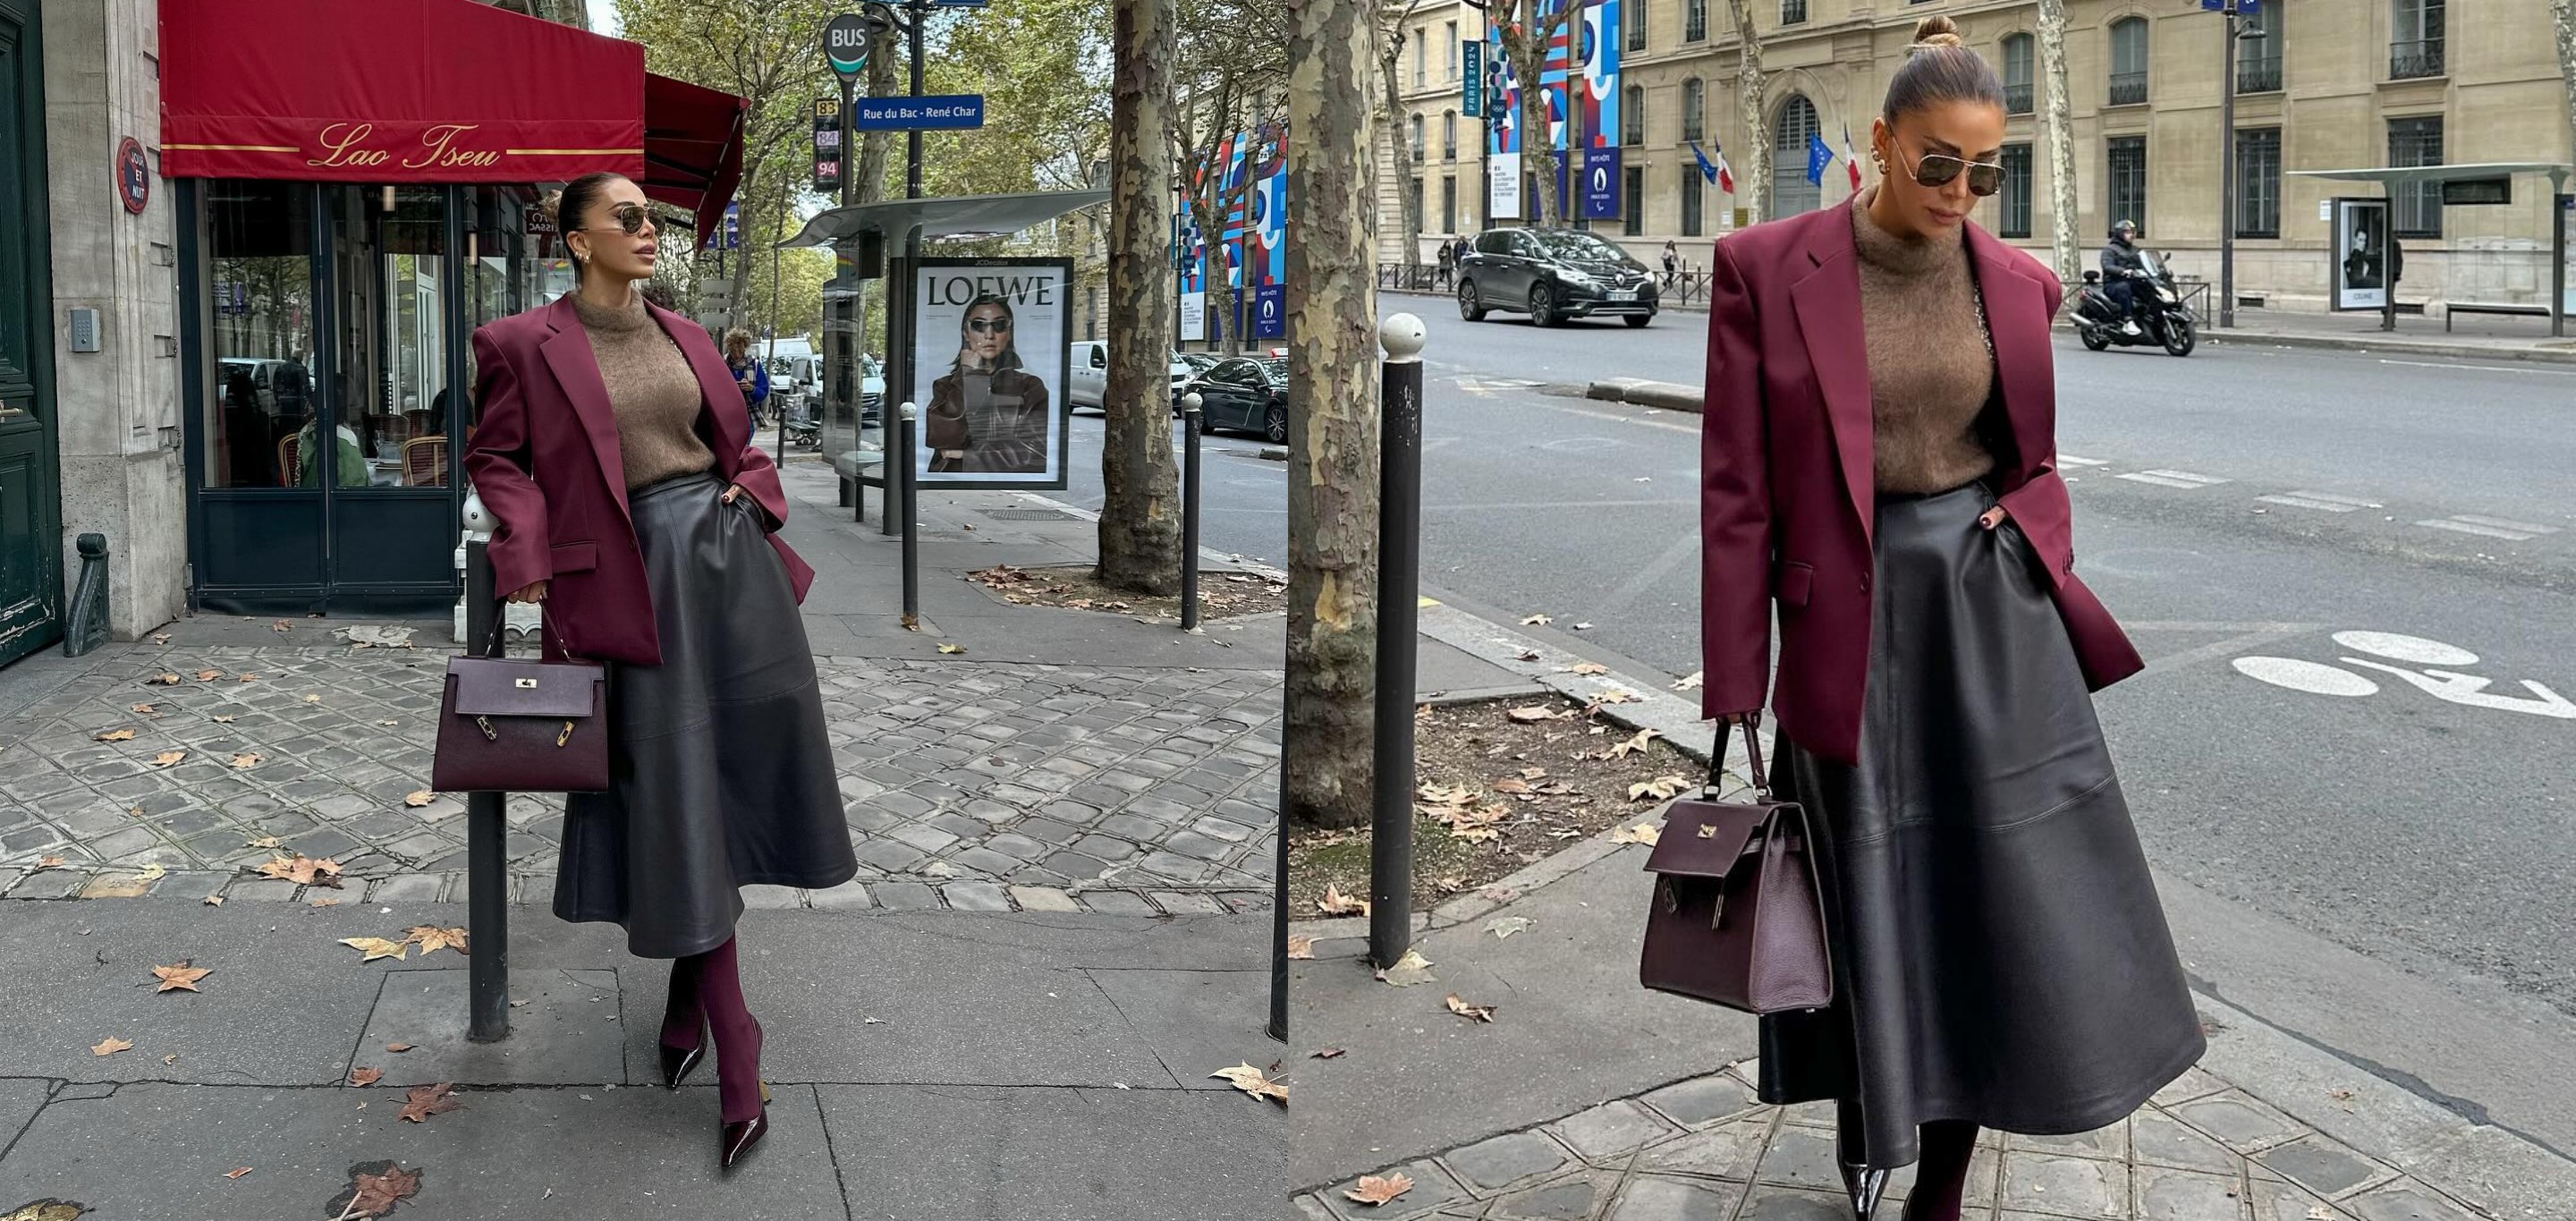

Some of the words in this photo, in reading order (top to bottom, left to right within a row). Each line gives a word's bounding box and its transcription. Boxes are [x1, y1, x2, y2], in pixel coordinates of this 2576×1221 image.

[831, 28, 866, 47] BUS
[1468, 47, 1476, 75] 2024
[1468, 86, 1476, 111] PARIS
[818, 102, 835, 114] 83
[863, 109, 883, 119] Rue
[885, 108, 898, 119] du
[900, 108, 918, 118] Bac
[926, 106, 951, 117] René
[953, 106, 977, 117] Char
[306, 123, 391, 167] Lao
[402, 123, 501, 169] Tseu
[818, 132, 836, 145] 84
[131, 151, 144, 167] JOUR
[135, 169, 142, 182] ET
[818, 162, 837, 176] 94
[132, 185, 144, 199] NUIT
[927, 276, 1055, 306] LOEWE
